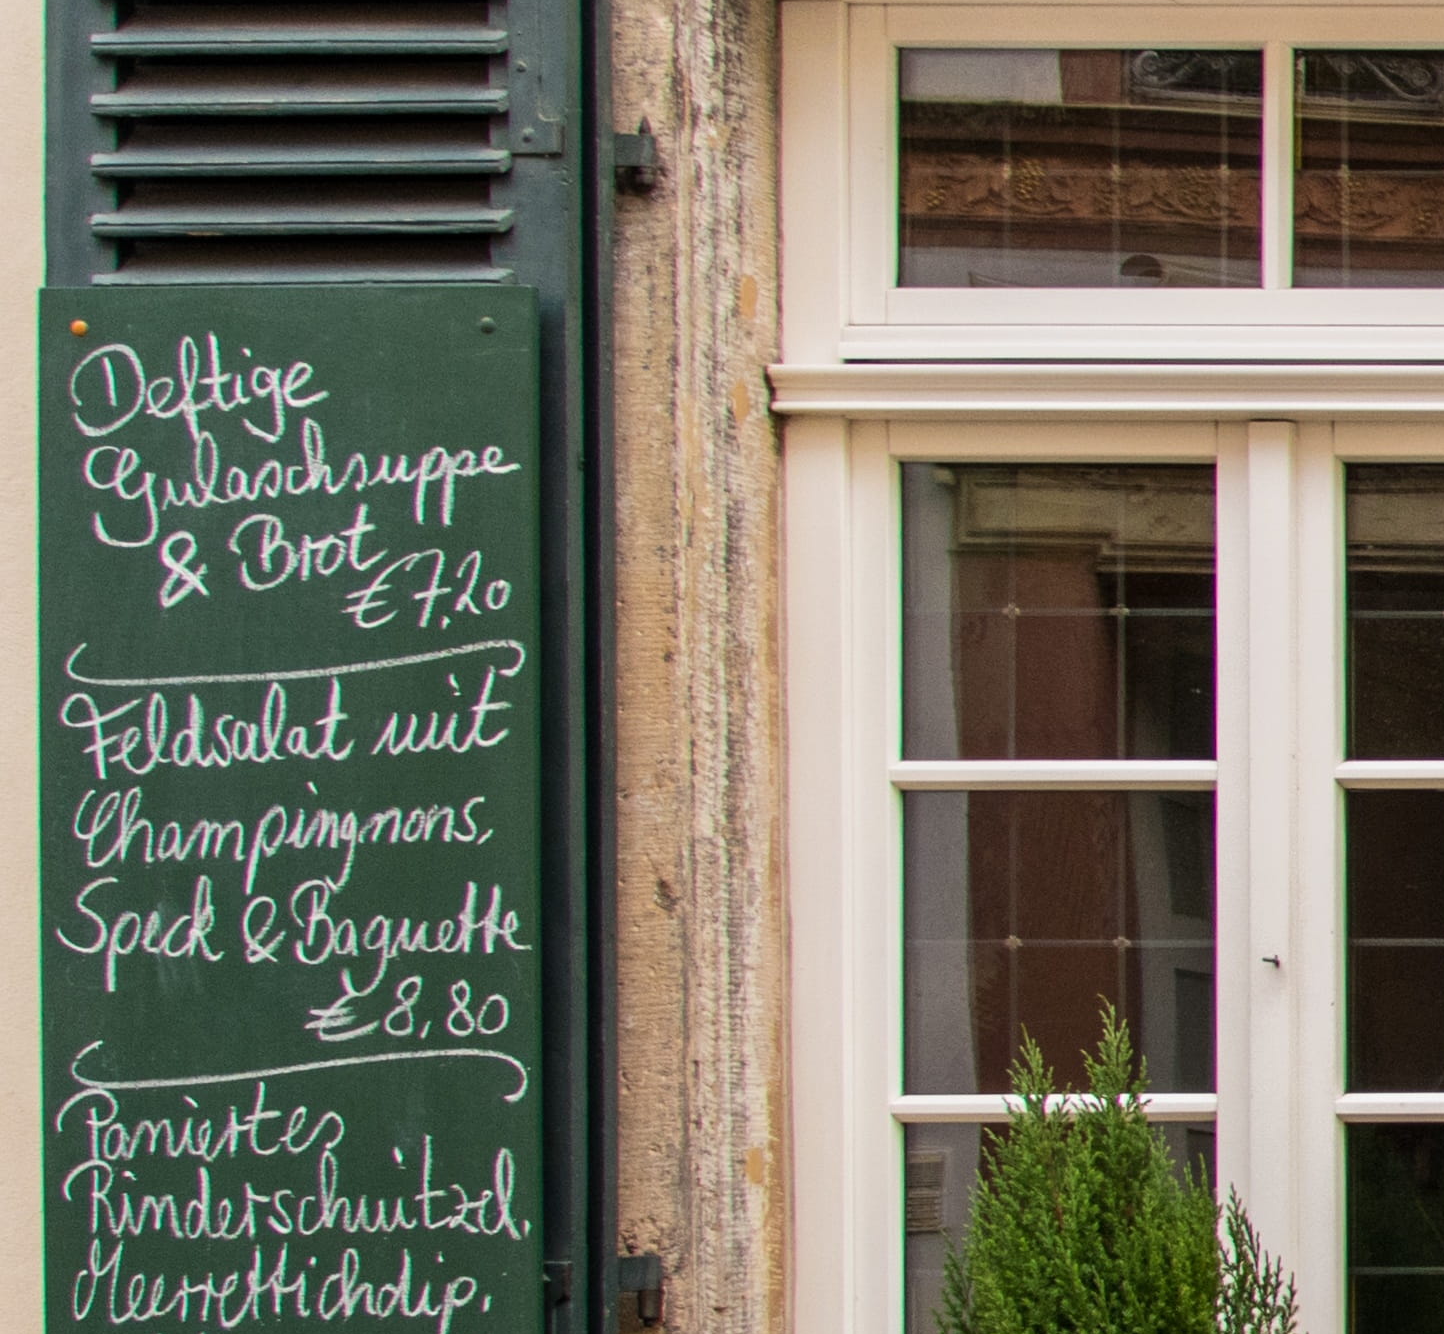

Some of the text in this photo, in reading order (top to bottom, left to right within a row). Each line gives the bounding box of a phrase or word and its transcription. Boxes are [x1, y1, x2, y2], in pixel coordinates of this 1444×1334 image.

[71, 332, 328, 442] Deftige
[83, 418, 520, 547] Gulaschsuppe
[161, 504, 387, 608] & Brot
[60, 666, 510, 779] Feldsalat mit
[56, 875, 224, 992] Speck
[242, 895, 286, 964] &
[57, 1082, 345, 1162] Paniertes
